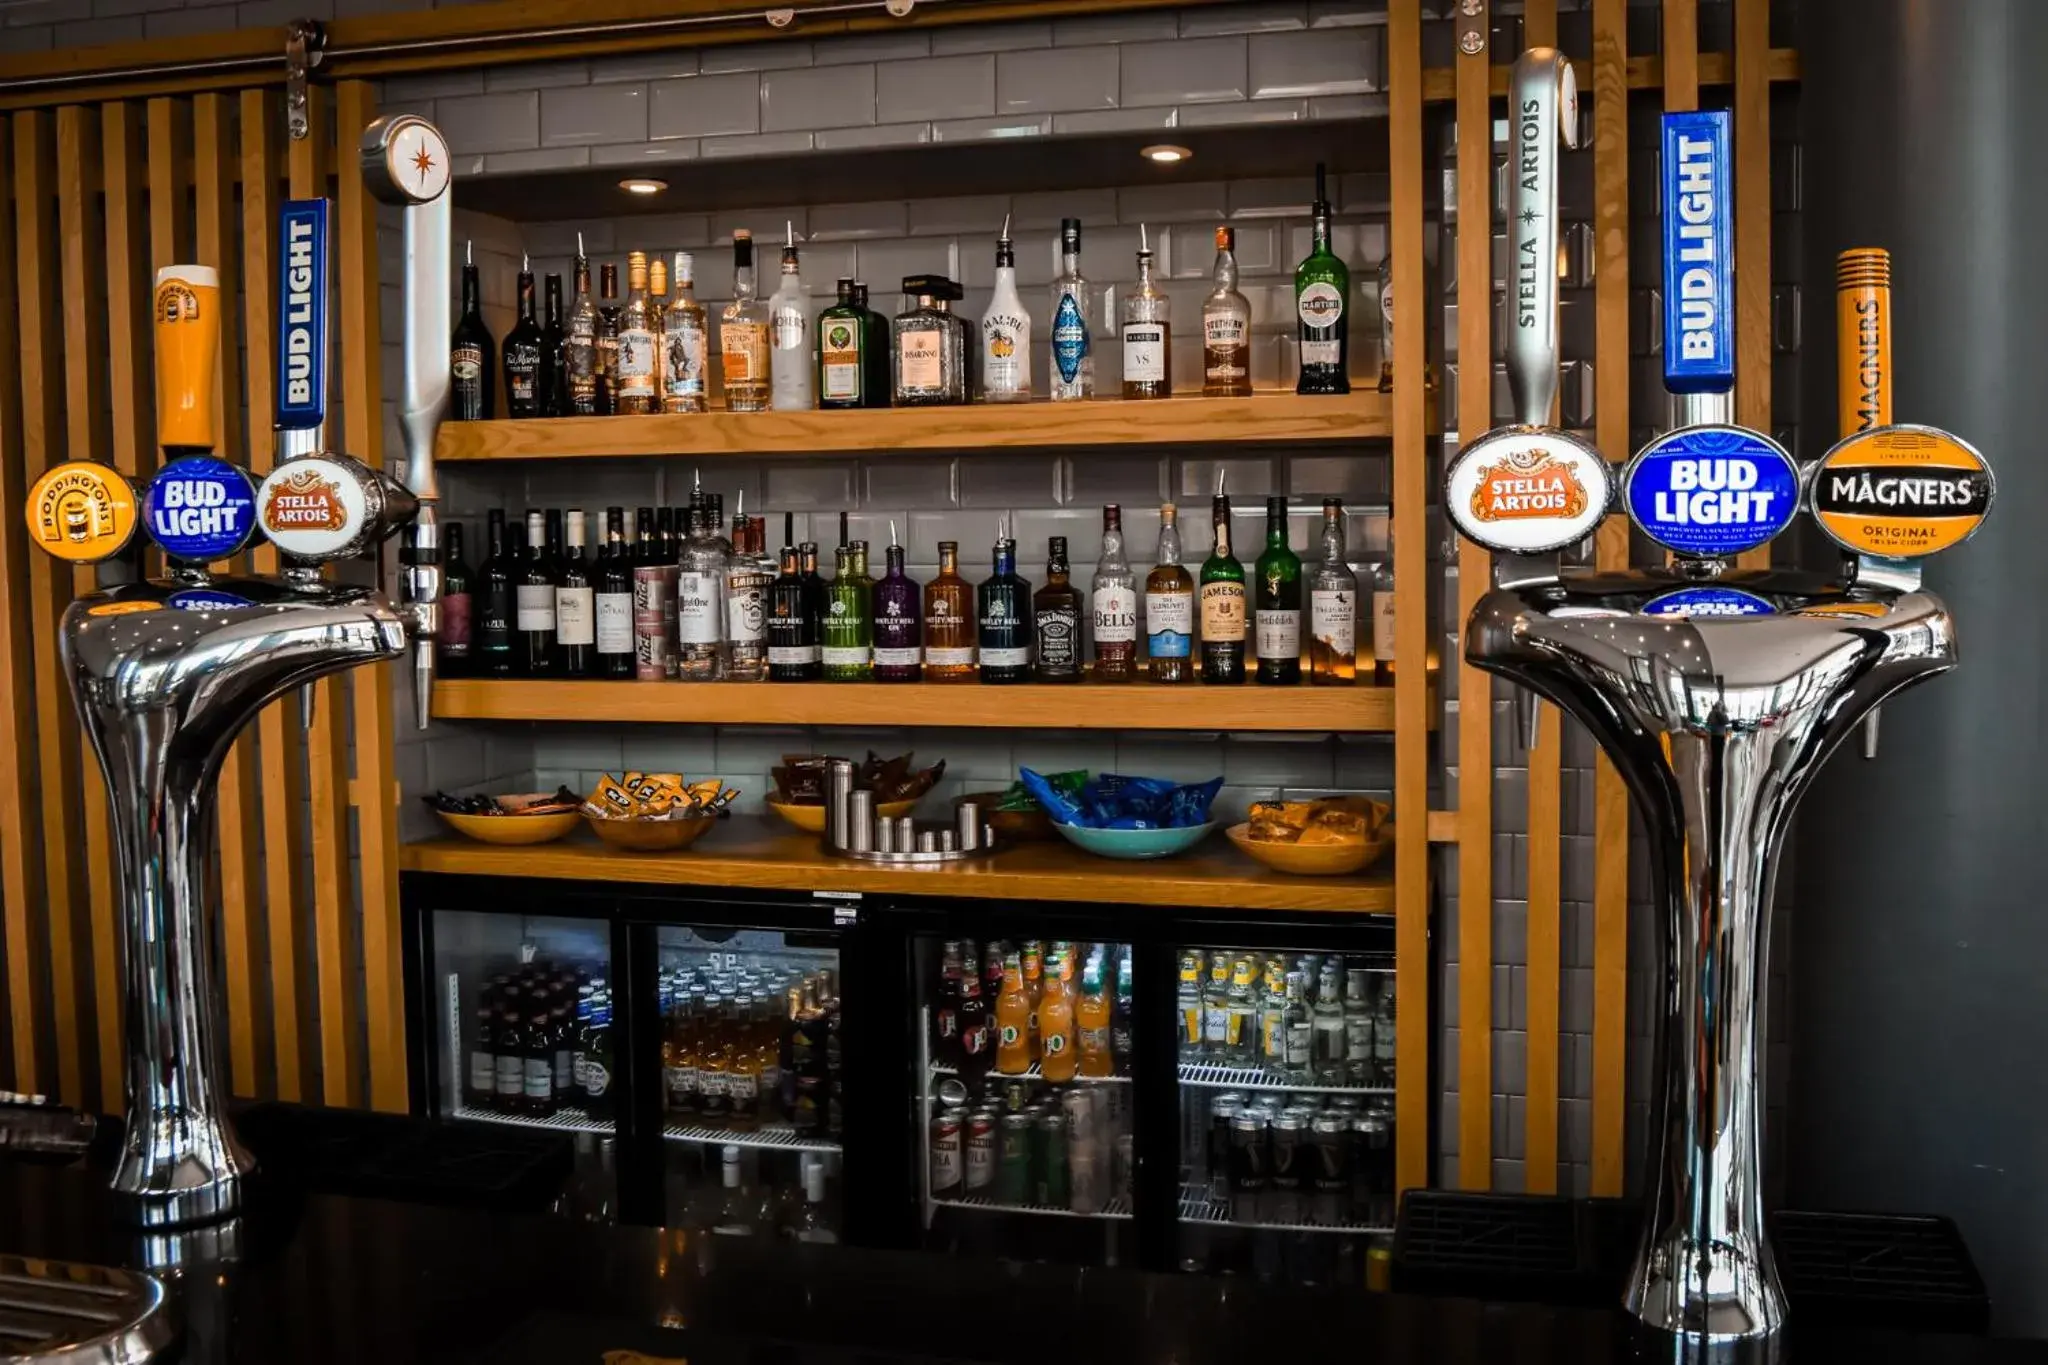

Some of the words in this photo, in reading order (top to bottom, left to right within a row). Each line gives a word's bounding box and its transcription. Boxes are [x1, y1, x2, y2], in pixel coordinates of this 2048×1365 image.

[1520, 99, 1541, 193] ARTOIS
[1680, 136, 1715, 266] LIGHT
[289, 219, 314, 322] LIGHT
[1518, 238, 1538, 328] STELLA
[1301, 300, 1339, 311] MARTINI
[1681, 271, 1716, 361] BUD
[982, 313, 1025, 334] MALIBU
[287, 325, 312, 405] BUD
[1857, 299, 1881, 432] MAGNERS
[1491, 478, 1566, 494] STELLA
[1670, 459, 1758, 491] BUD
[1831, 474, 1973, 506] MAGNERS
[44, 475, 110, 527] BODDINGTONS
[164, 481, 226, 508] BUD
[276, 495, 329, 509] STELLA
[1491, 493, 1566, 511] ARTOIS
[1655, 491, 1775, 525] LIGHT
[154, 508, 238, 536] LIGHT
[277, 508, 331, 523] ARTOIS
[1863, 525, 1938, 539] ORIGINAL
[638, 577, 649, 611] NICE
[1201, 585, 1245, 601] JAMESON
[1095, 609, 1136, 628] BELL'S
[640, 631, 653, 667] NICE
